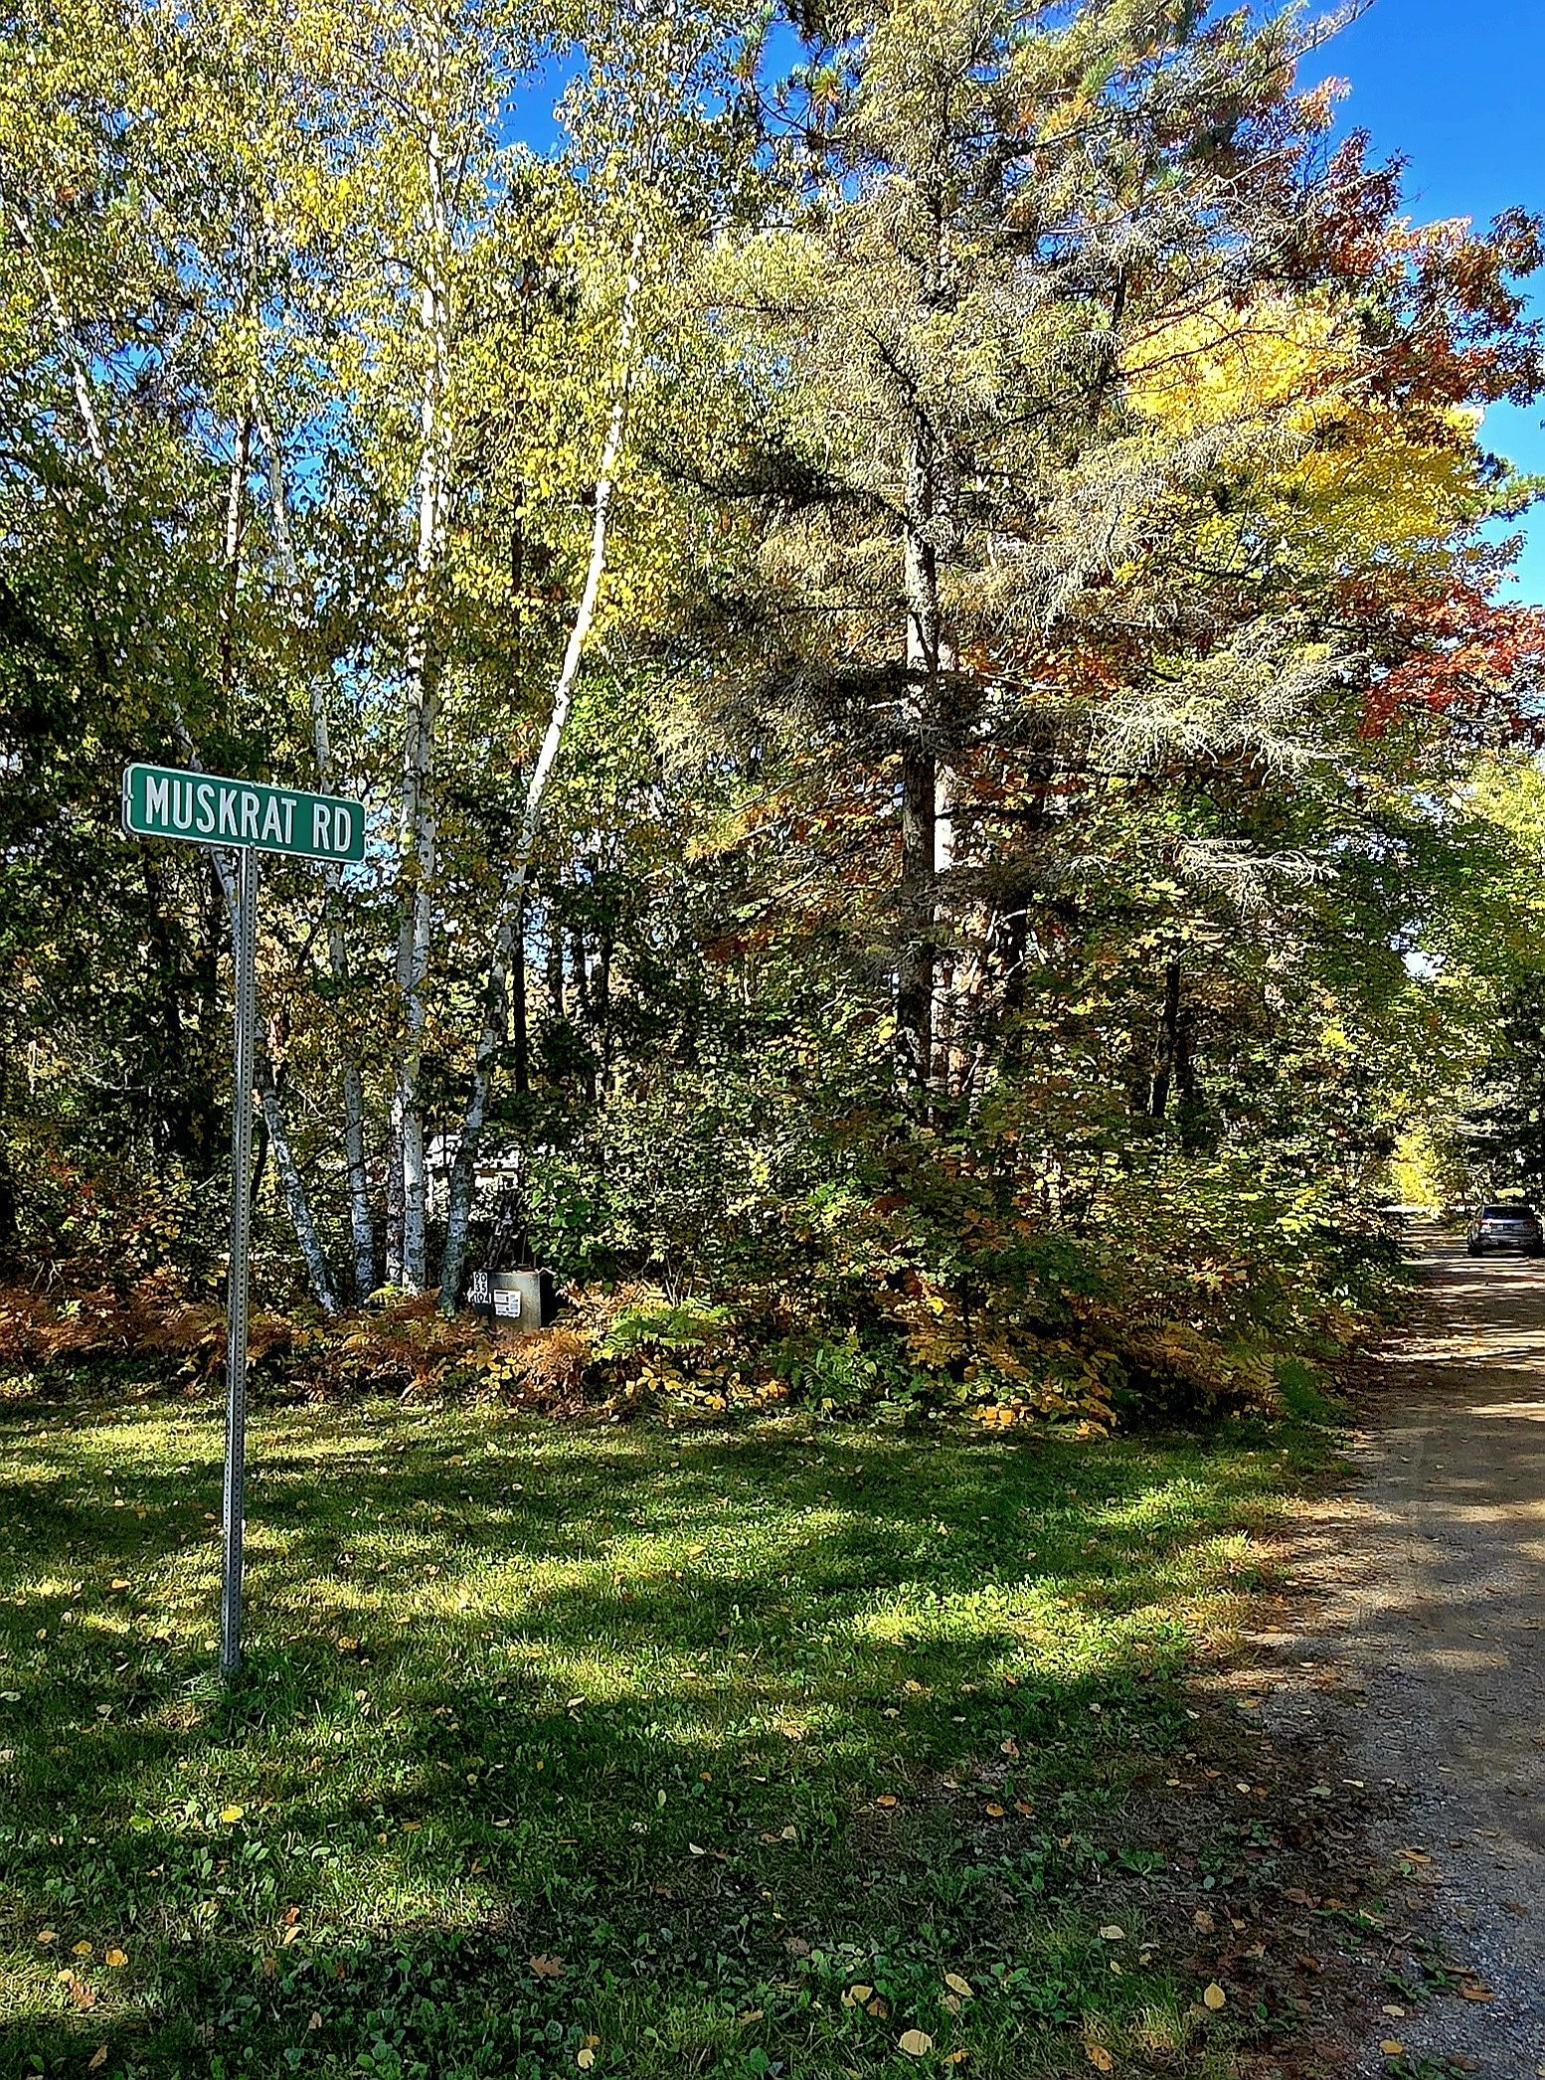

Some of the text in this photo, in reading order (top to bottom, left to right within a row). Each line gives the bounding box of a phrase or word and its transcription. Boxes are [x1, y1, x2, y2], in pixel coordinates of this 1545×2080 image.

[145, 775, 352, 852] MUSKRAT RD
[474, 1272, 487, 1282] 90
[475, 1283, 487, 1293] 35
